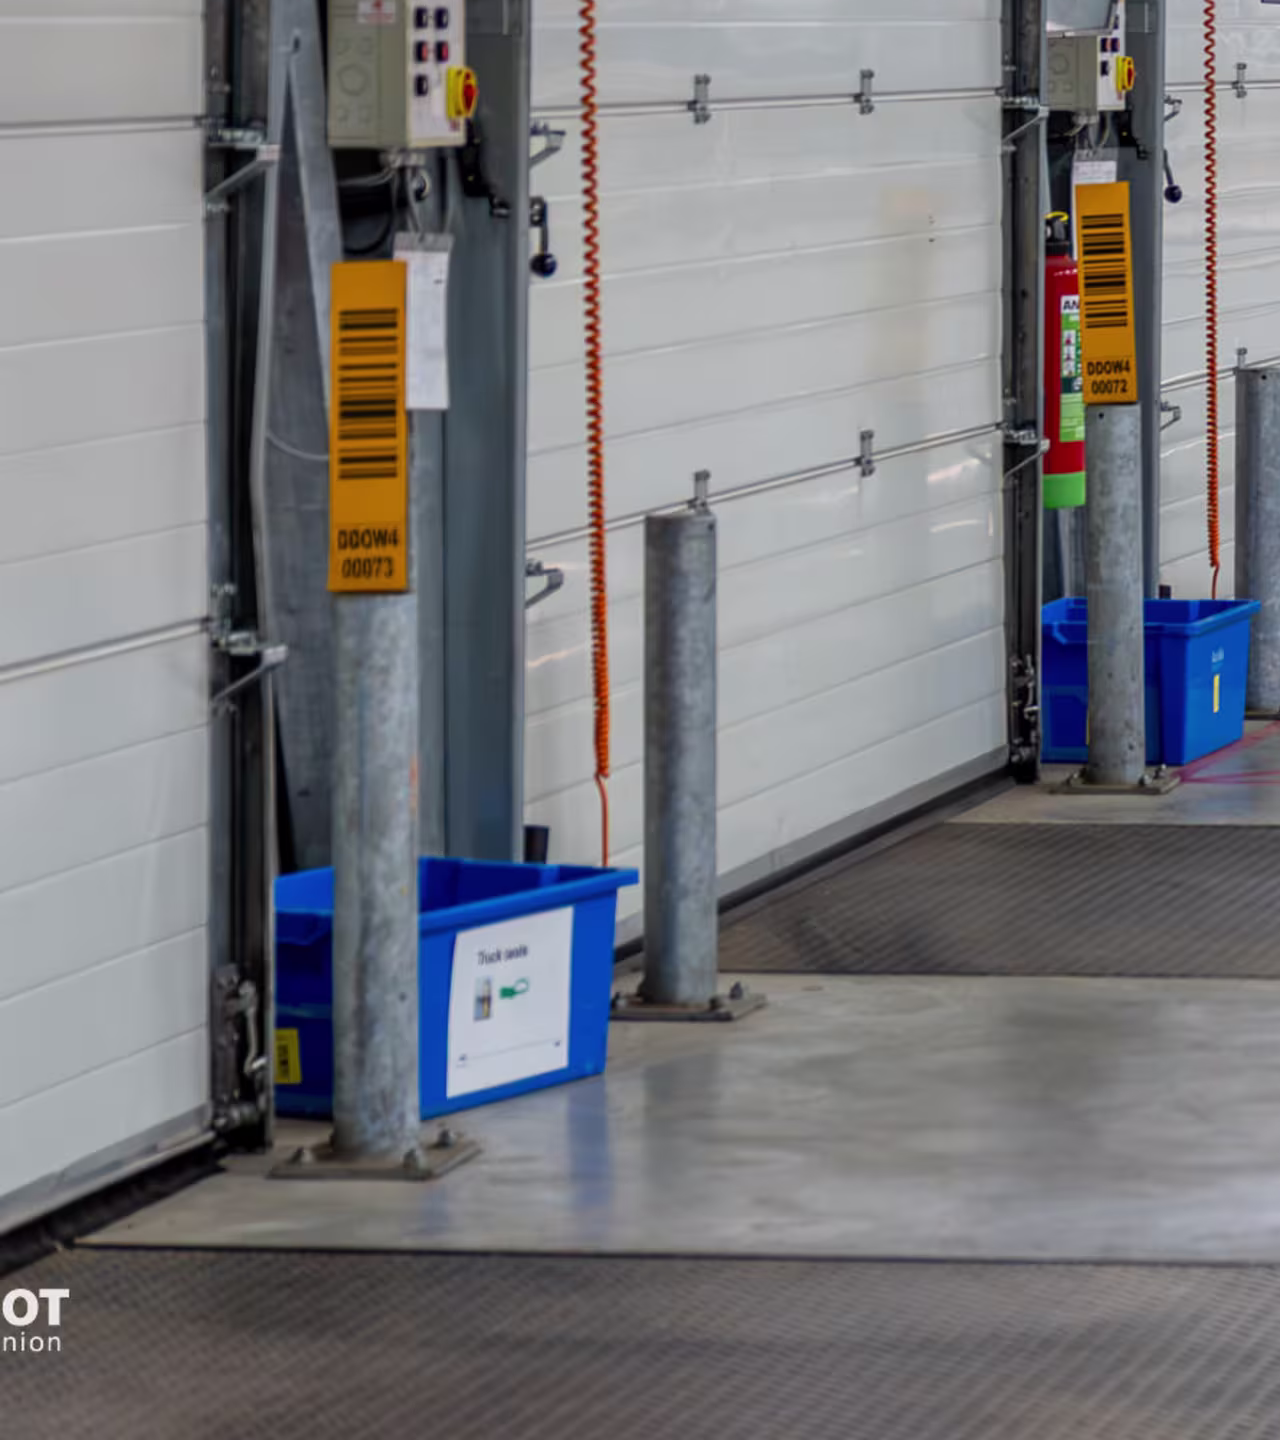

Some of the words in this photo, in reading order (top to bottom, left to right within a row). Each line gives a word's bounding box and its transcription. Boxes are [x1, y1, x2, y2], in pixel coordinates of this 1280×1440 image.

[1087, 360, 1130, 376] DDOW4
[1092, 379, 1128, 394] 00072
[338, 527, 399, 550] DDOW4
